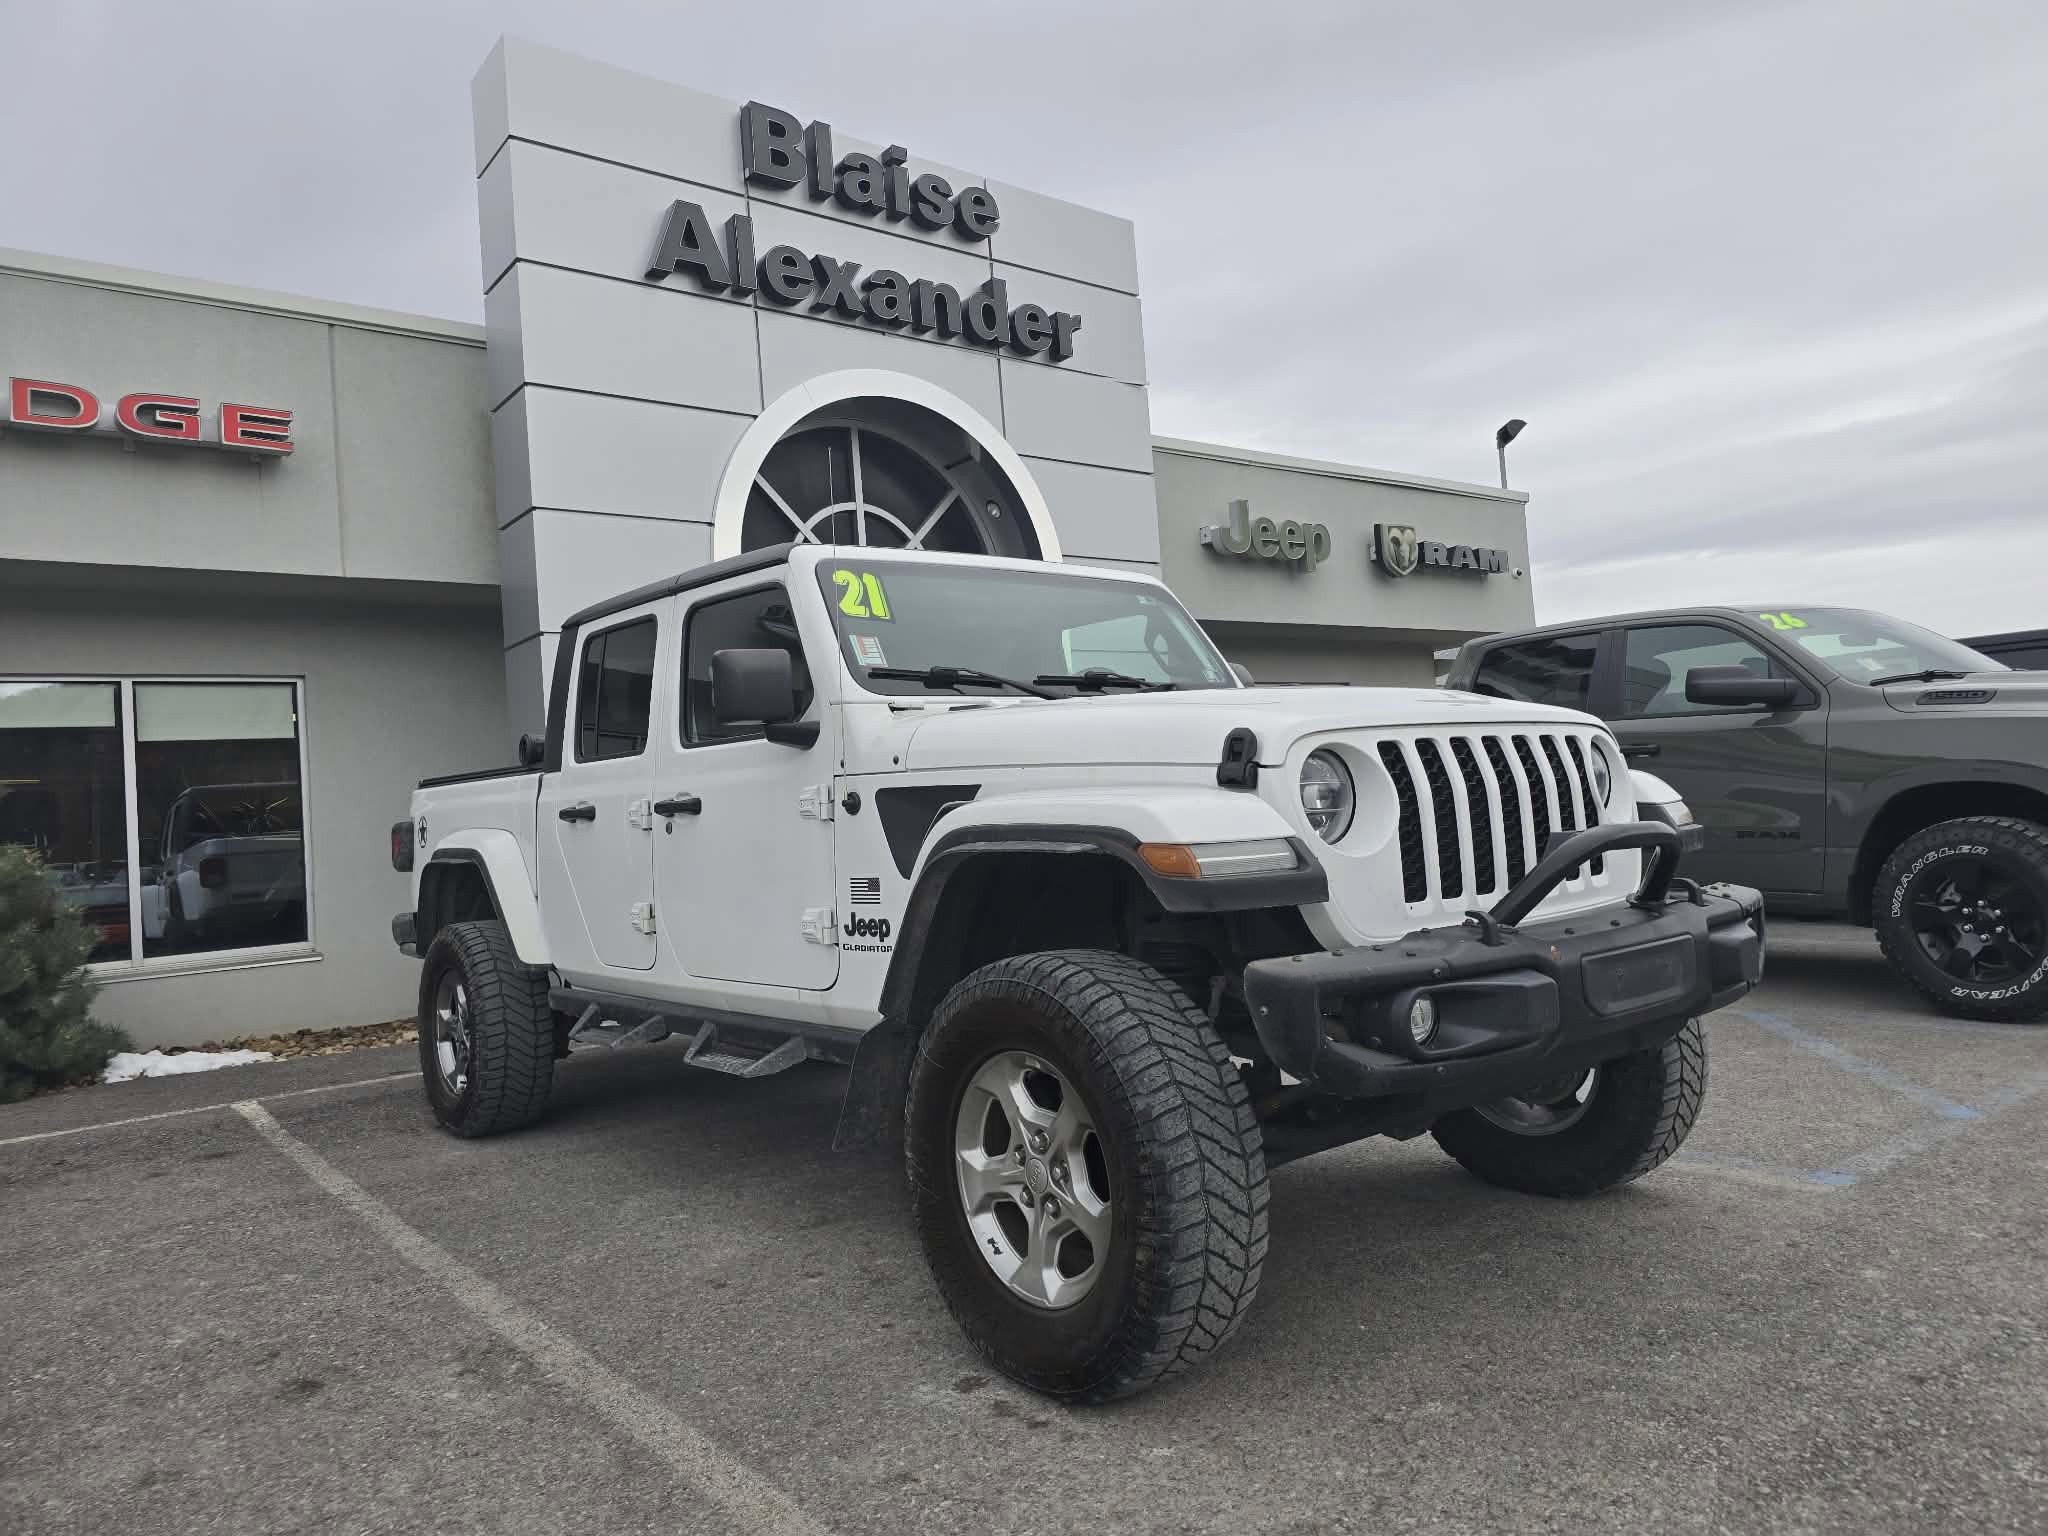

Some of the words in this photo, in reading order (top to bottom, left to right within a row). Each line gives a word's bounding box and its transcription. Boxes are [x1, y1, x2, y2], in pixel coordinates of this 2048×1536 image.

[740, 100, 1000, 241] Blaise
[645, 199, 1082, 361] Alexander
[1210, 499, 1332, 573] Jeep
[1417, 541, 1509, 574] RAM
[832, 569, 891, 620] 21
[1891, 844, 1989, 918] WRANGLER
[842, 943, 893, 953] GLADIATOR
[843, 911, 891, 943] Jeep
